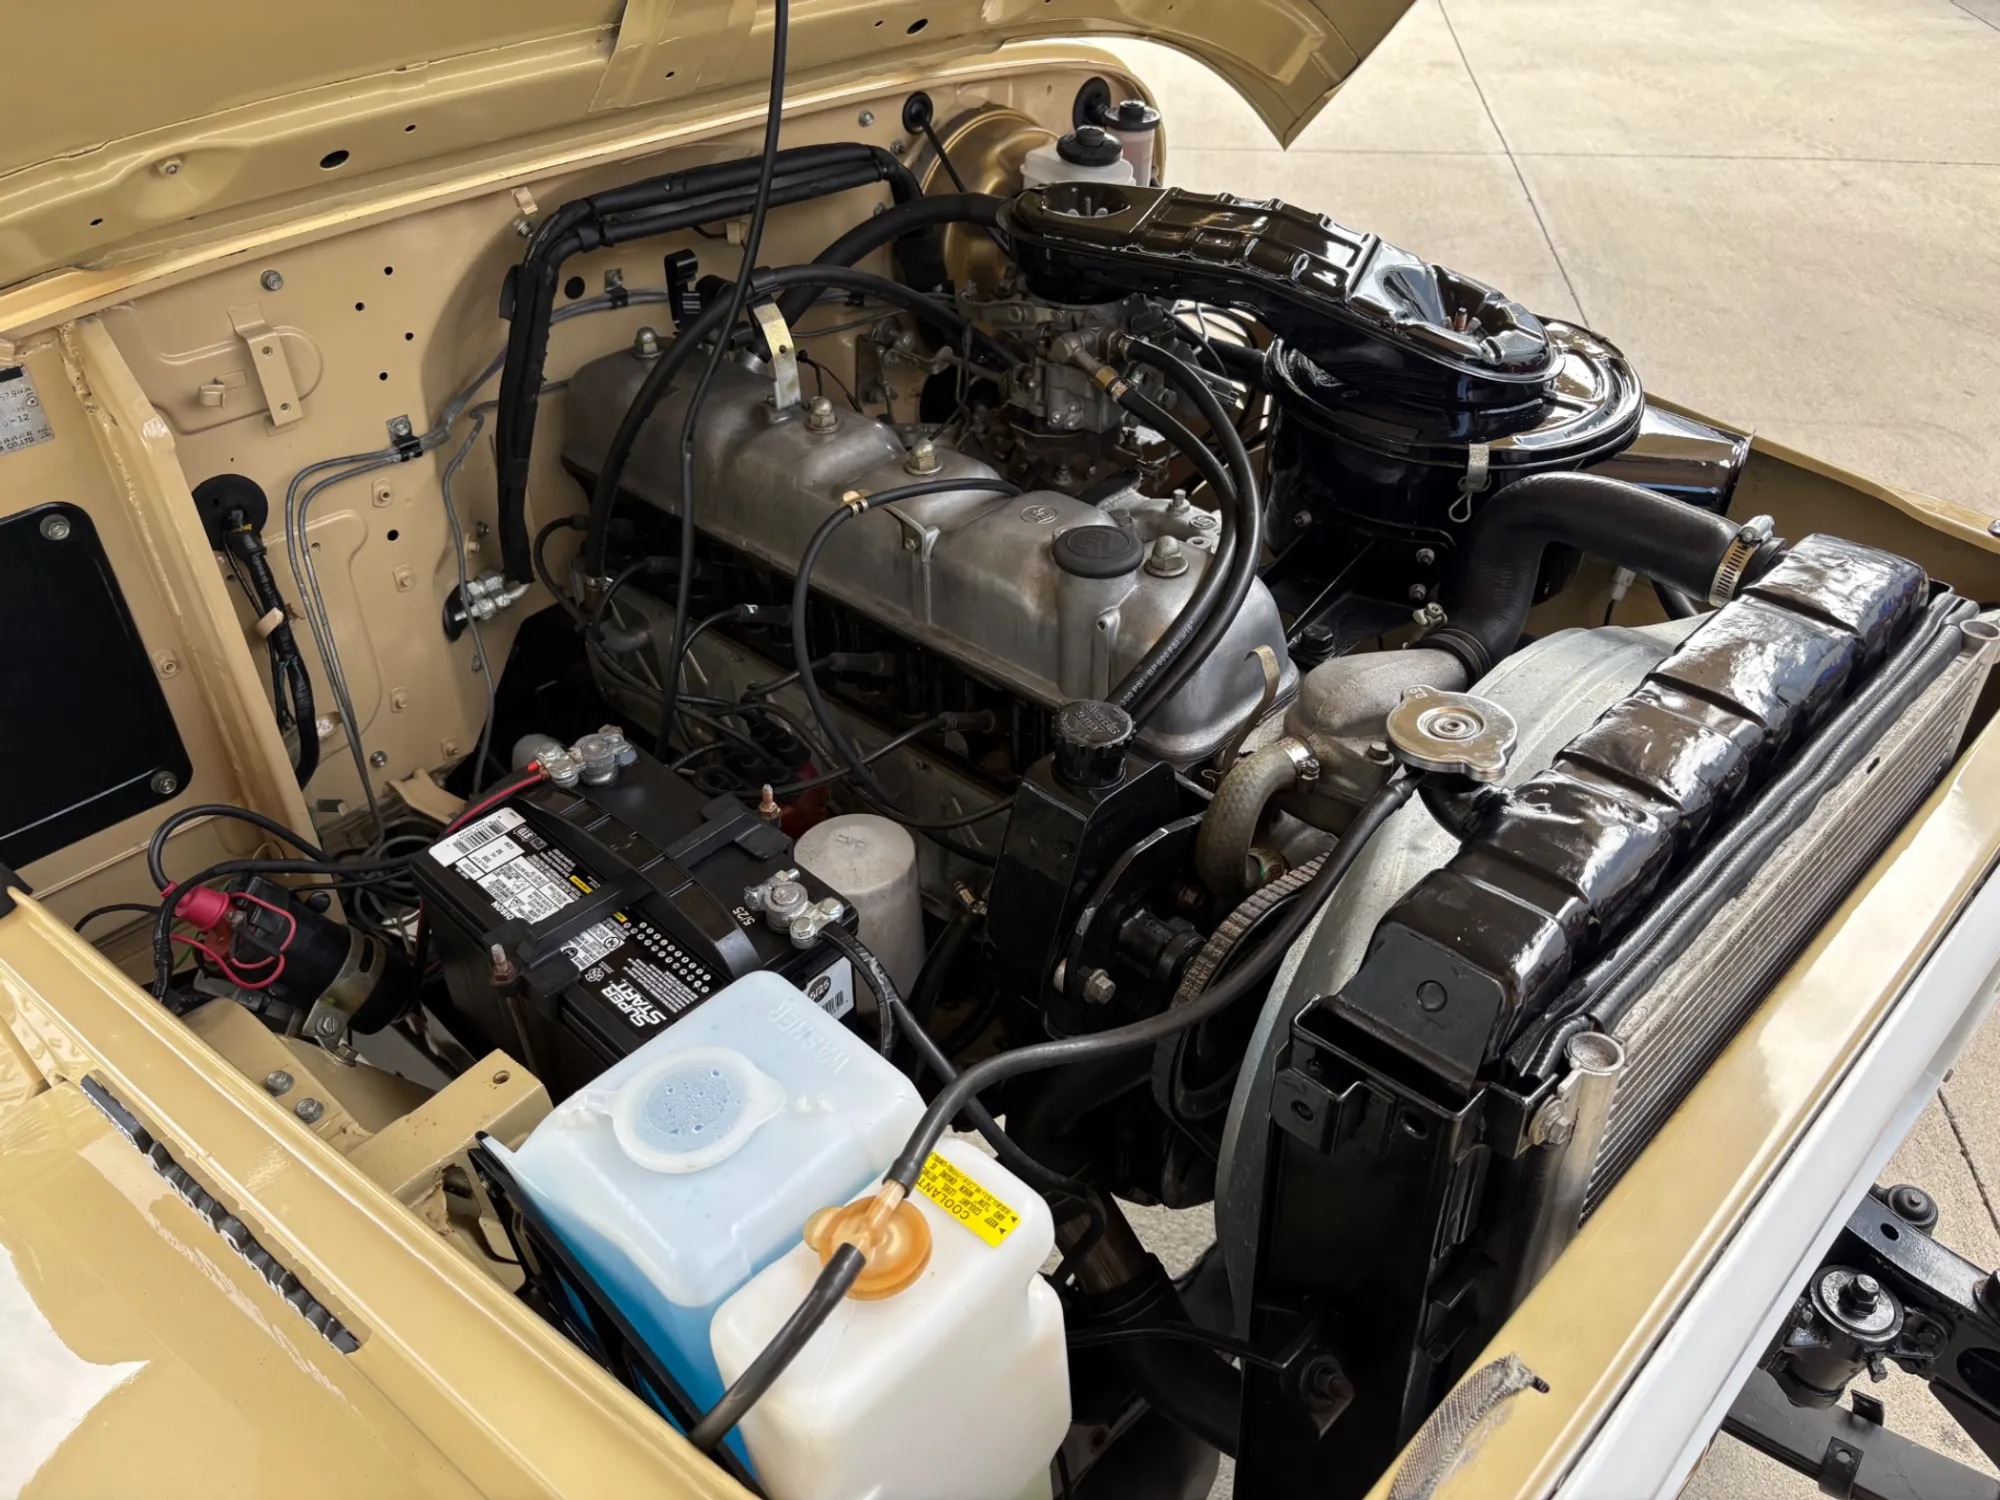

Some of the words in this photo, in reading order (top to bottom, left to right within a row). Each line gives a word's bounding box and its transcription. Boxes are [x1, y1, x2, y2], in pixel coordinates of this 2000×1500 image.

[1130, 677, 1146, 693] PSI
[1146, 662, 1159, 677] BP
[1166, 638, 1181, 654] PSI
[731, 904, 756, 927] 5/25
[600, 985, 651, 1027] SUPER
[610, 980, 667, 1024] START
[768, 1003, 850, 1075] WASHER
[915, 1177, 971, 1221] COOLANT
